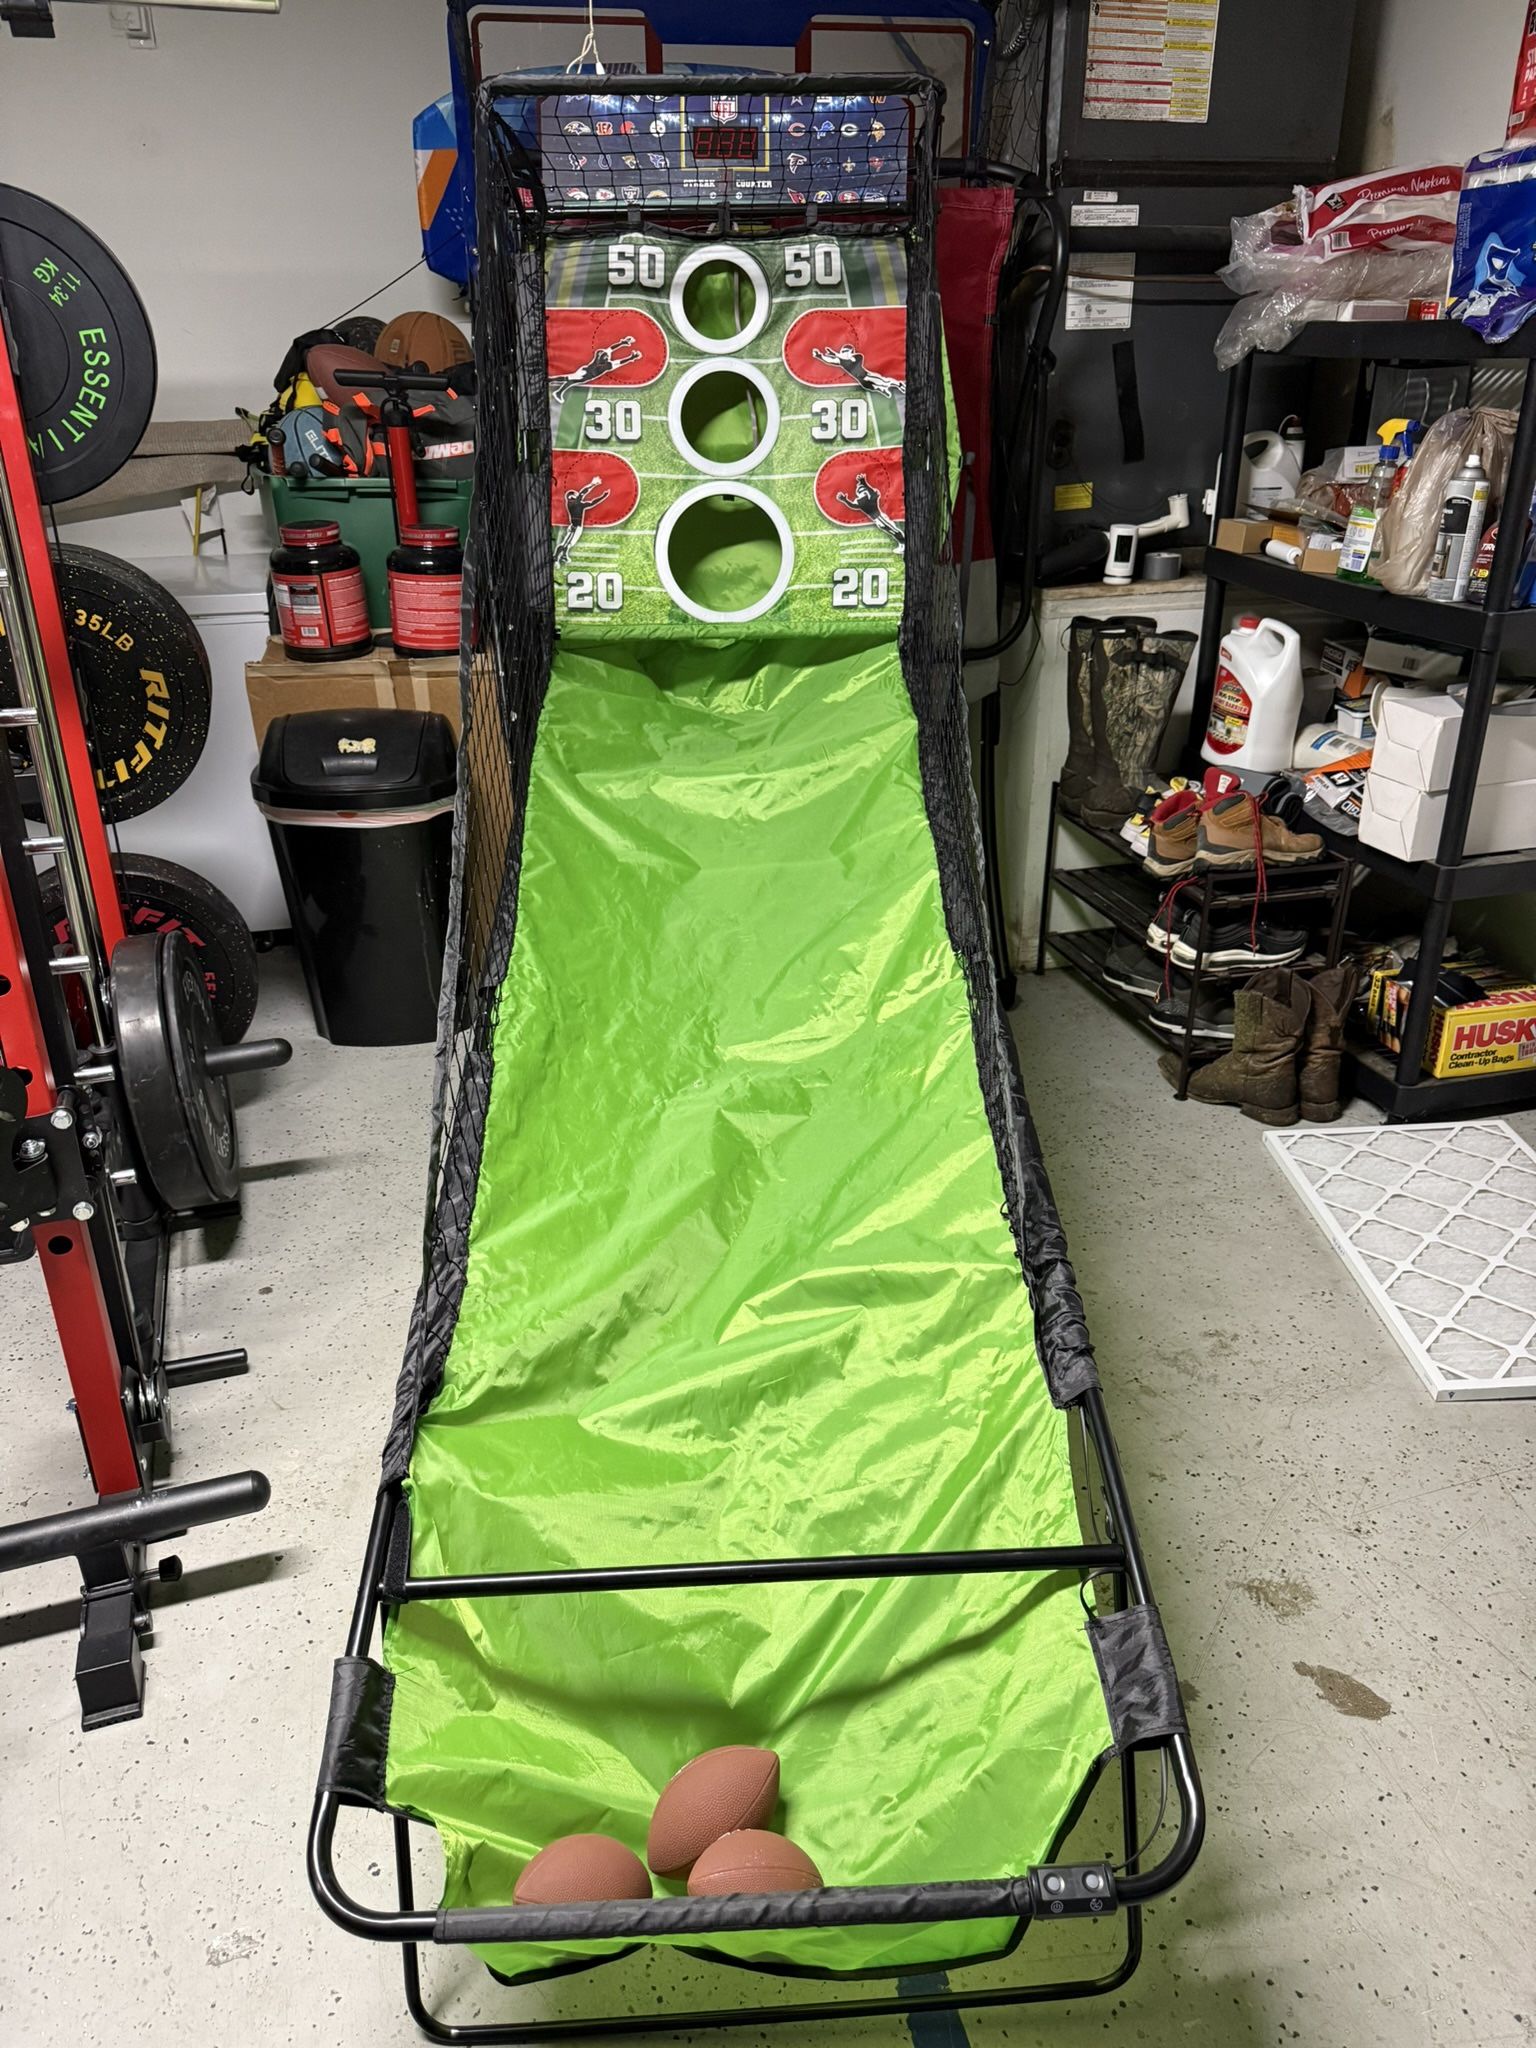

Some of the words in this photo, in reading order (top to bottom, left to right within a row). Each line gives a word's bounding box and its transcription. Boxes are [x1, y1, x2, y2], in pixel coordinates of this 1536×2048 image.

[713, 101, 733, 118] NFL
[683, 179, 716, 188] STREAK
[736, 180, 772, 188] COUNTER
[1357, 183, 1408, 201] Premium
[1410, 175, 1450, 192] Napkins
[1367, 222, 1414, 239] Premium
[33, 257, 59, 284] KG
[608, 244, 666, 288] 50
[785, 243, 841, 288] 50
[48, 271, 82, 308] 11.34
[585, 399, 642, 441] 30
[811, 398, 868, 441] 30
[567, 571, 624, 611] 20
[832, 568, 889, 607] 20
[74, 608, 135, 652] 35LB
[1452, 1017, 1536, 1051] HUSK
[1450, 1049, 1498, 1061] Contractor
[1491, 1054, 1514, 1064] Bags
